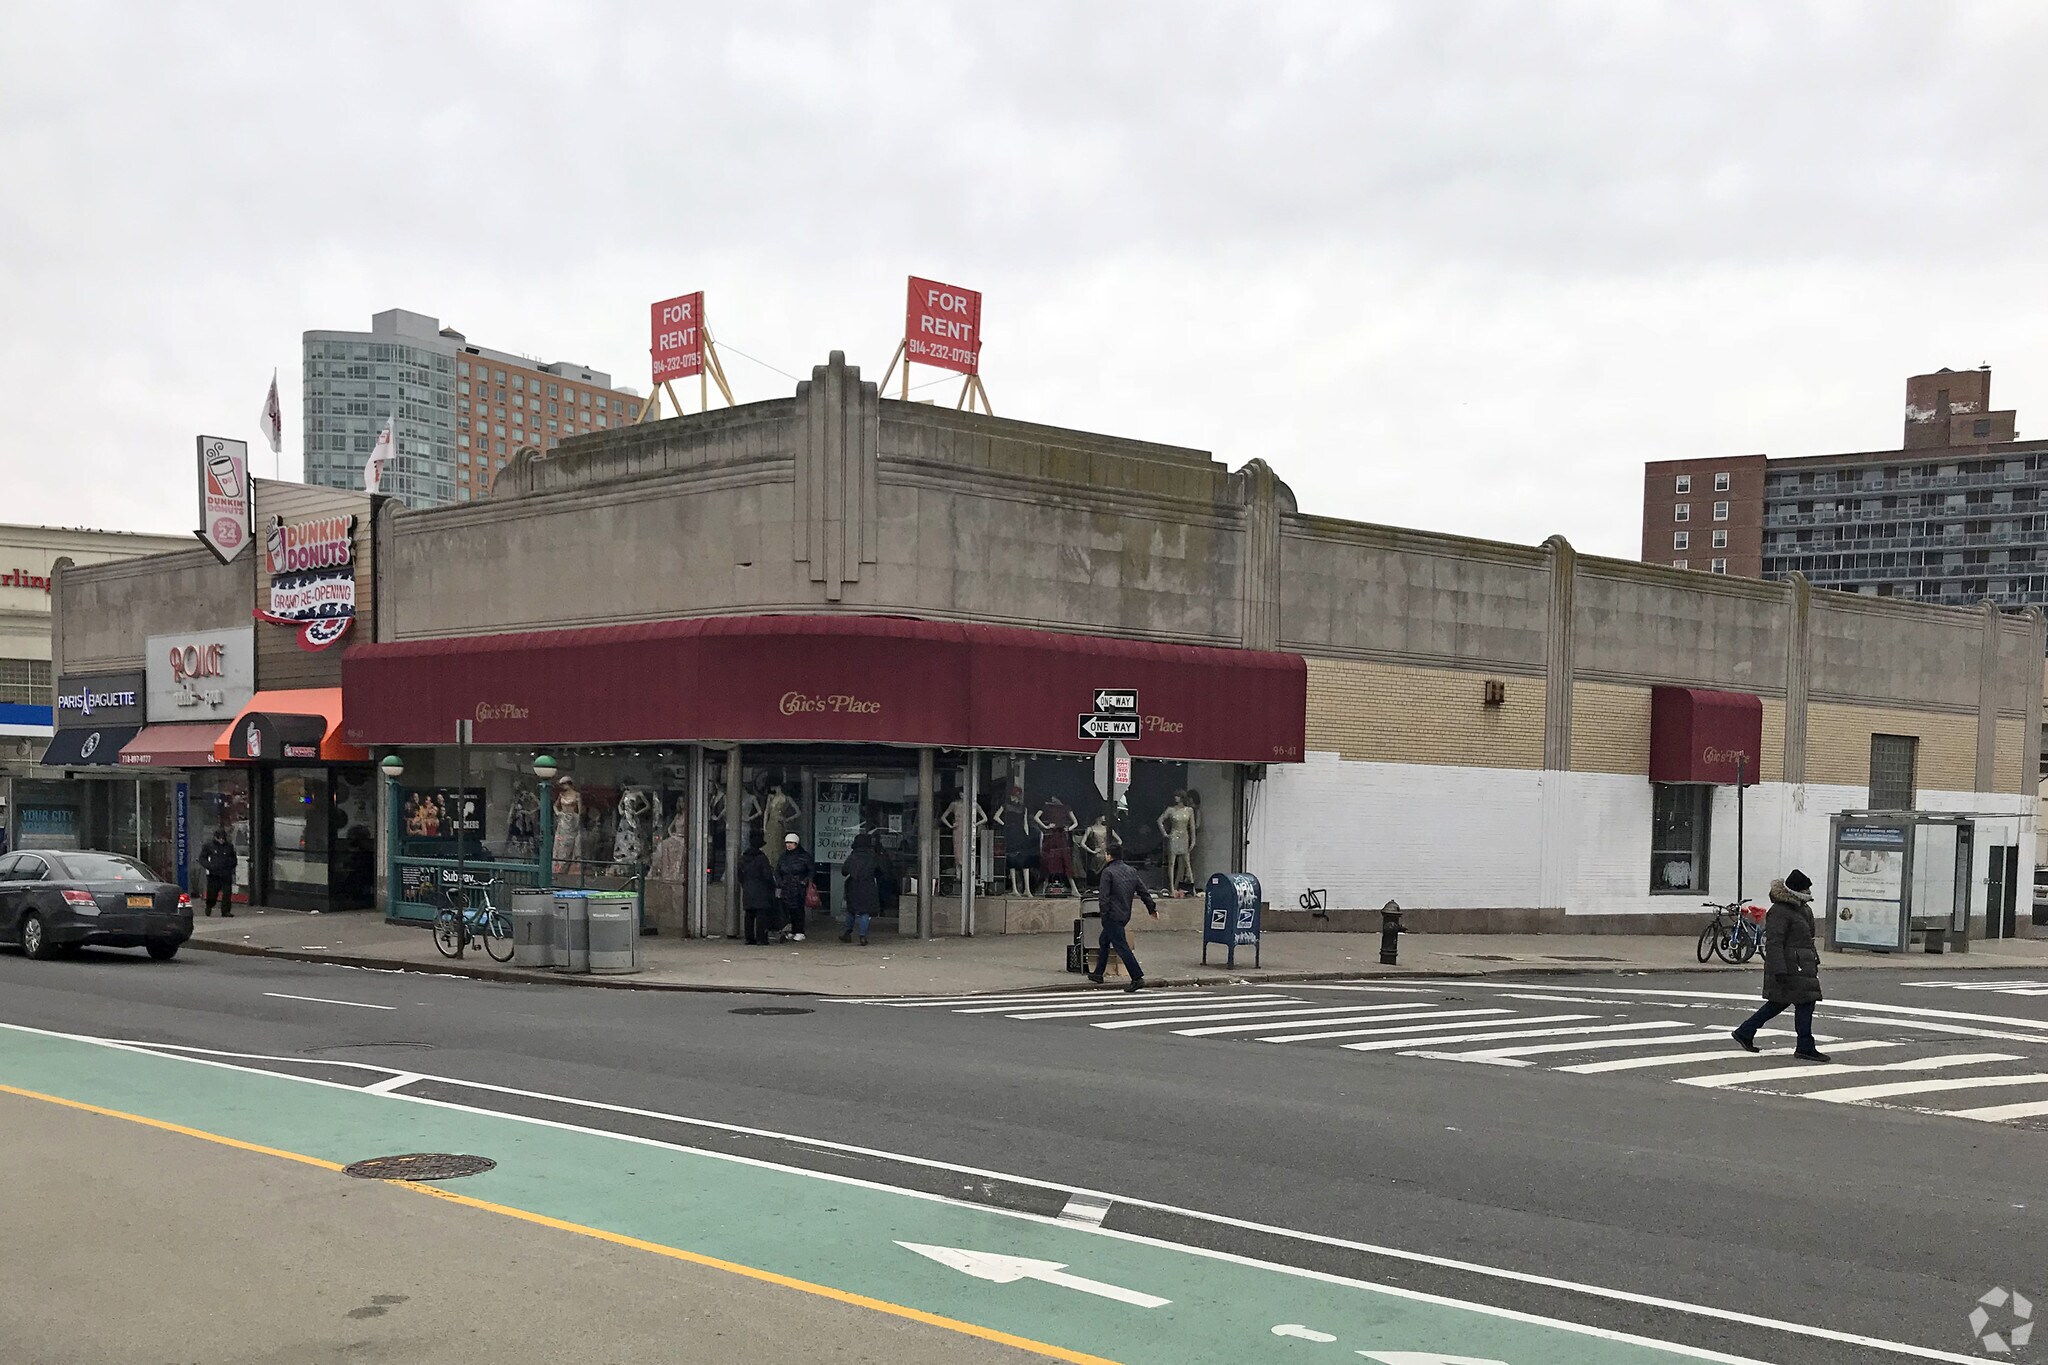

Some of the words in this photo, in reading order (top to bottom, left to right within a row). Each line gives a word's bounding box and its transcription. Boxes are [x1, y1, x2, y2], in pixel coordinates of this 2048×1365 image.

[928, 289, 967, 315] FOR
[663, 303, 691, 325] FOR
[921, 314, 972, 342] RENT
[660, 327, 696, 351] RENT
[908, 339, 977, 366] 914-232-0795
[653, 351, 702, 374] 914-232-0795
[207, 496, 246, 508] DUNKIN'
[207, 504, 244, 516] DONUTS
[218, 528, 237, 539] 24
[287, 516, 351, 548] DUNKIN'
[287, 540, 348, 570] DONUTS
[274, 593, 300, 609] GRAND
[300, 584, 351, 606] RE-OPENING
[58, 694, 82, 709] PARIS
[88, 691, 135, 708] BAGUETTE
[779, 691, 827, 716] Chic's
[827, 694, 881, 714] Place
[1100, 696, 1114, 706] ONE
[1115, 697, 1131, 706] WAY
[501, 703, 529, 719] Place
[1090, 722, 1109, 732] ONE
[1113, 722, 1132, 732] WAY
[1145, 715, 1184, 733] Place
[22, 809, 49, 822] YOUR
[827, 815, 849, 825] OFF
[827, 850, 848, 860] OFF
